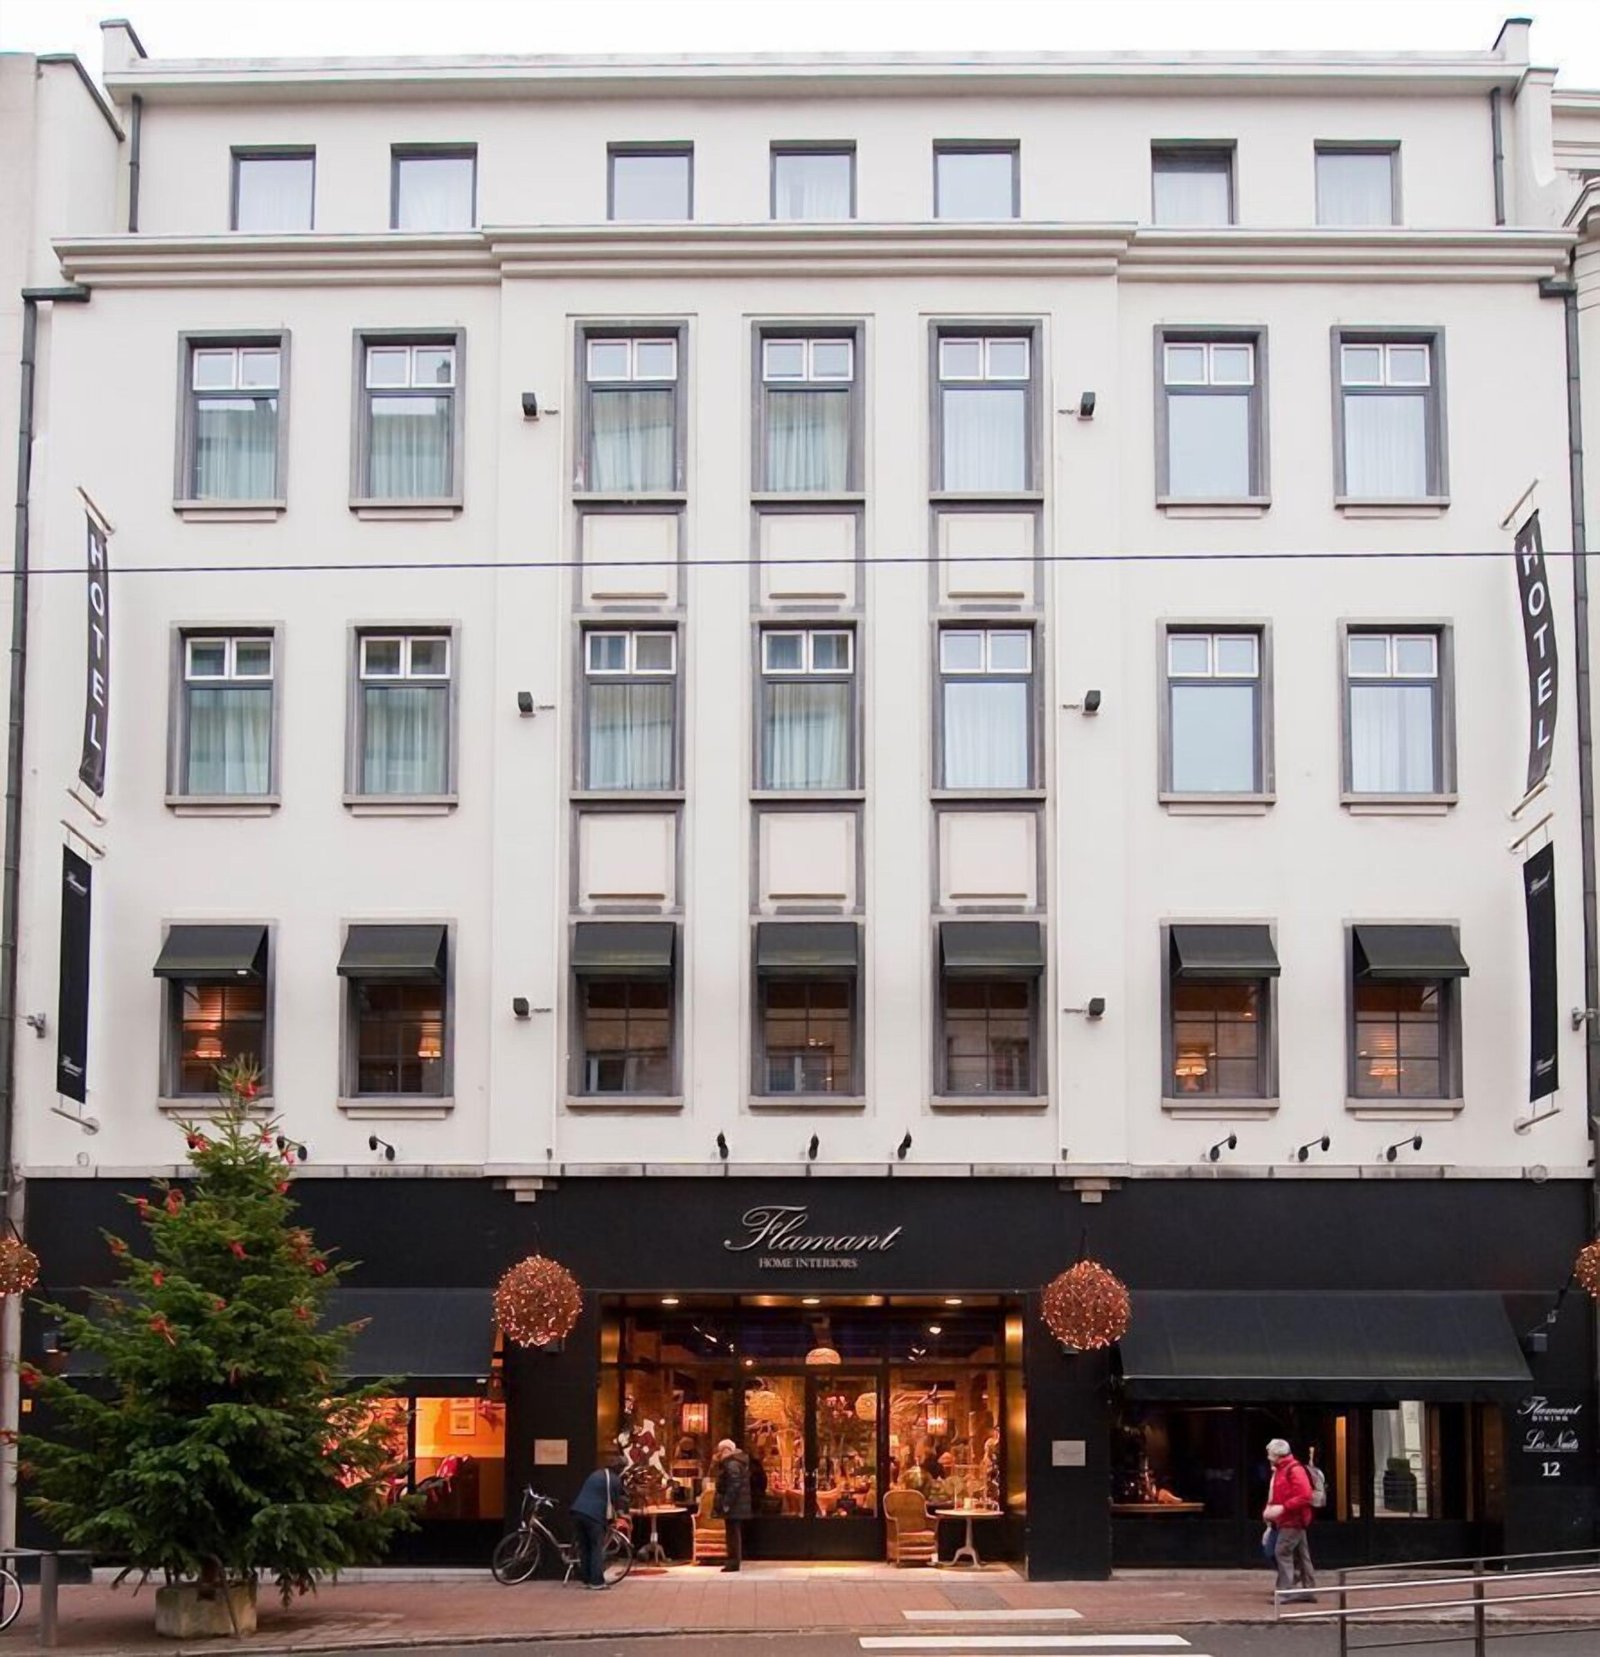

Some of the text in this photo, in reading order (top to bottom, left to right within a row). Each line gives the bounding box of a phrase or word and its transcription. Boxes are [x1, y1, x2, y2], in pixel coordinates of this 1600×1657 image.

[90, 534, 105, 751] HOTEL
[1522, 533, 1553, 750] HOTEL
[723, 1205, 903, 1252] Flamant
[759, 1257, 859, 1269] HOME INTERIORS
[1517, 1395, 1582, 1415] Flamant
[1542, 1461, 1561, 1477] 12
